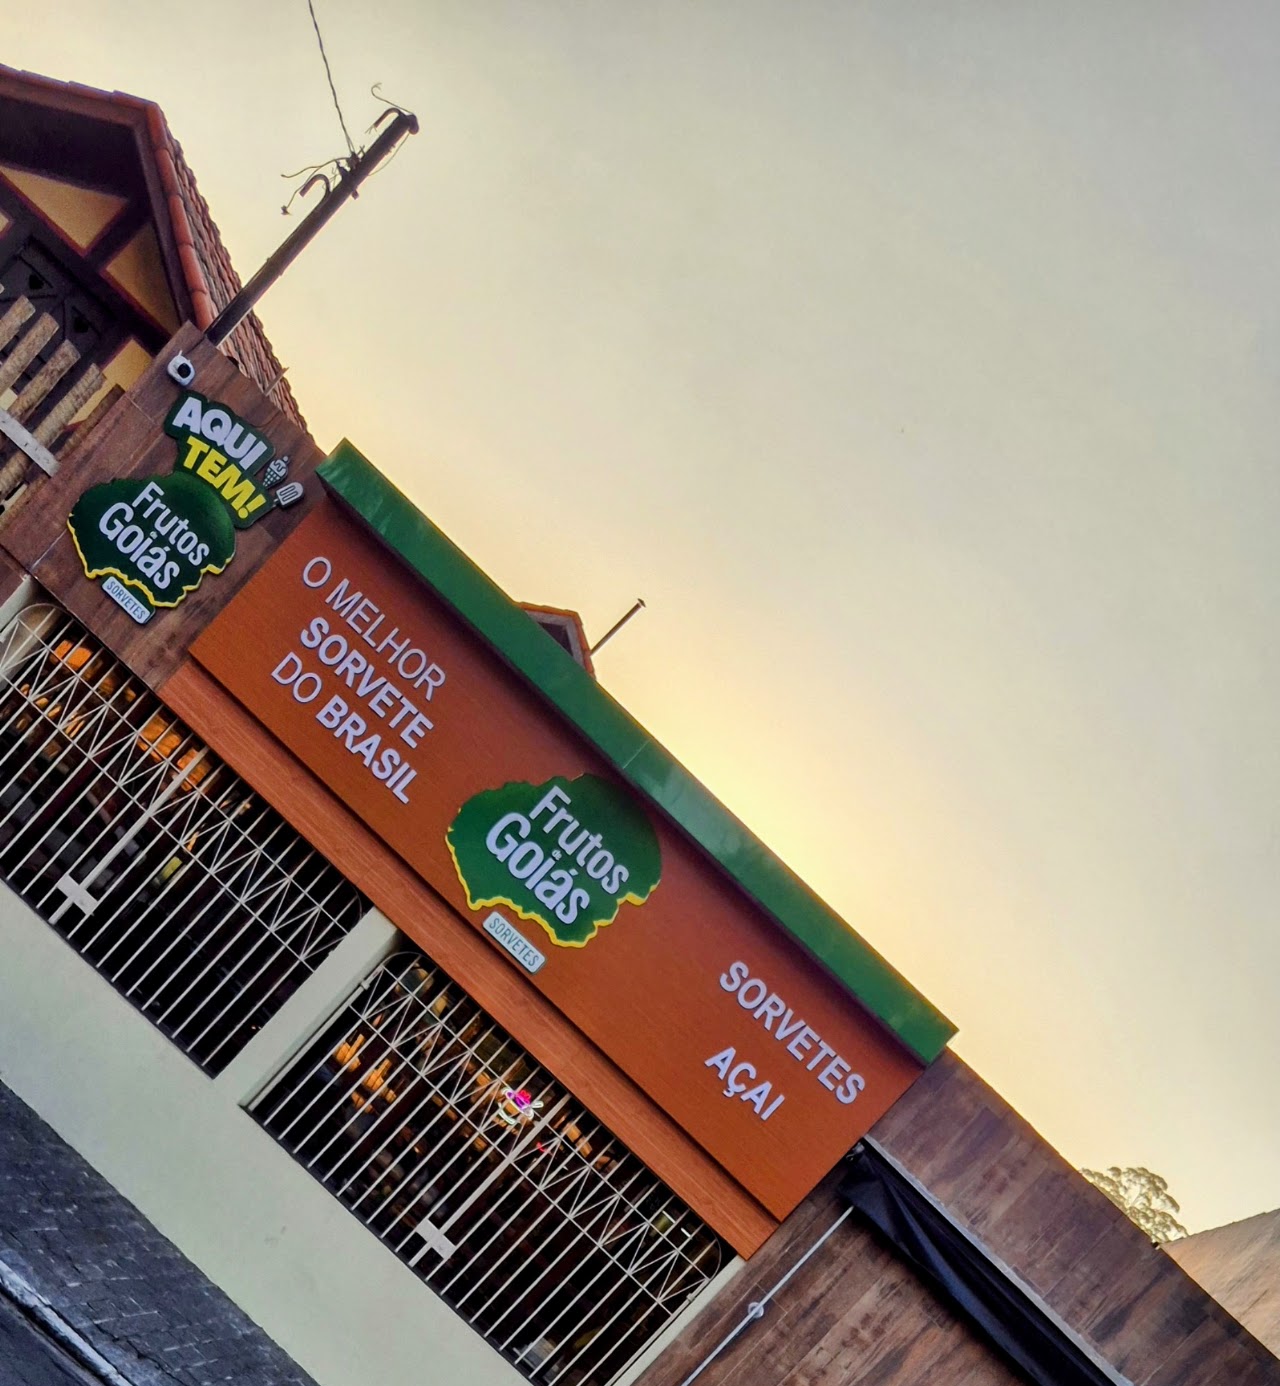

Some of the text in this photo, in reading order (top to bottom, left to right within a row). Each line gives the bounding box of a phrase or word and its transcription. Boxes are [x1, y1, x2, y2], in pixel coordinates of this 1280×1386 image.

[171, 396, 268, 470] AQUI
[184, 436, 267, 519] TEM!
[98, 501, 181, 590] Goiás
[131, 481, 211, 567] Frutos
[106, 579, 146, 621] SORVETES
[302, 556, 447, 702] O MELHOR
[300, 616, 435, 749] SORVETE
[271, 651, 419, 804] DO BRASIL
[486, 812, 590, 924] Goiás
[528, 785, 630, 895] Frutos
[488, 916, 541, 969] SORVETES
[719, 961, 867, 1106] SORVETES
[704, 1046, 787, 1122] AÇAI
